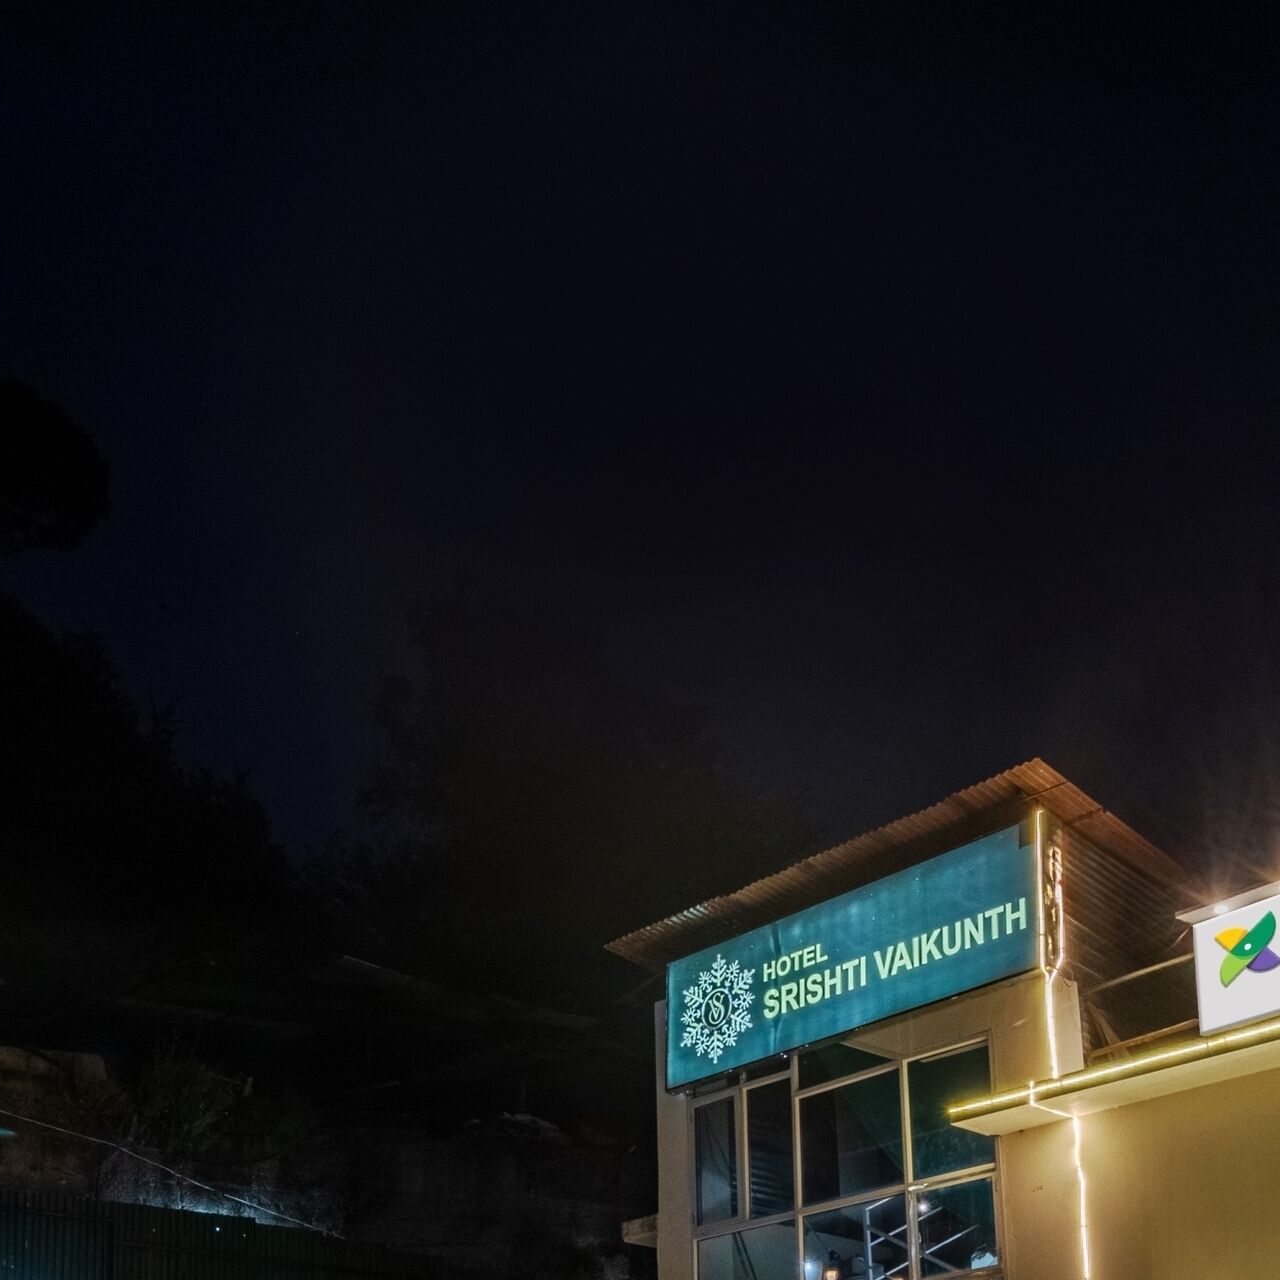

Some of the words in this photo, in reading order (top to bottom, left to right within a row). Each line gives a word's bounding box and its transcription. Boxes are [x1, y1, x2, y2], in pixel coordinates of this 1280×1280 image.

[763, 957, 867, 1019] SRISHTI
[874, 897, 1027, 980] VAIKUNTH
[763, 943, 828, 982] HOTEL
